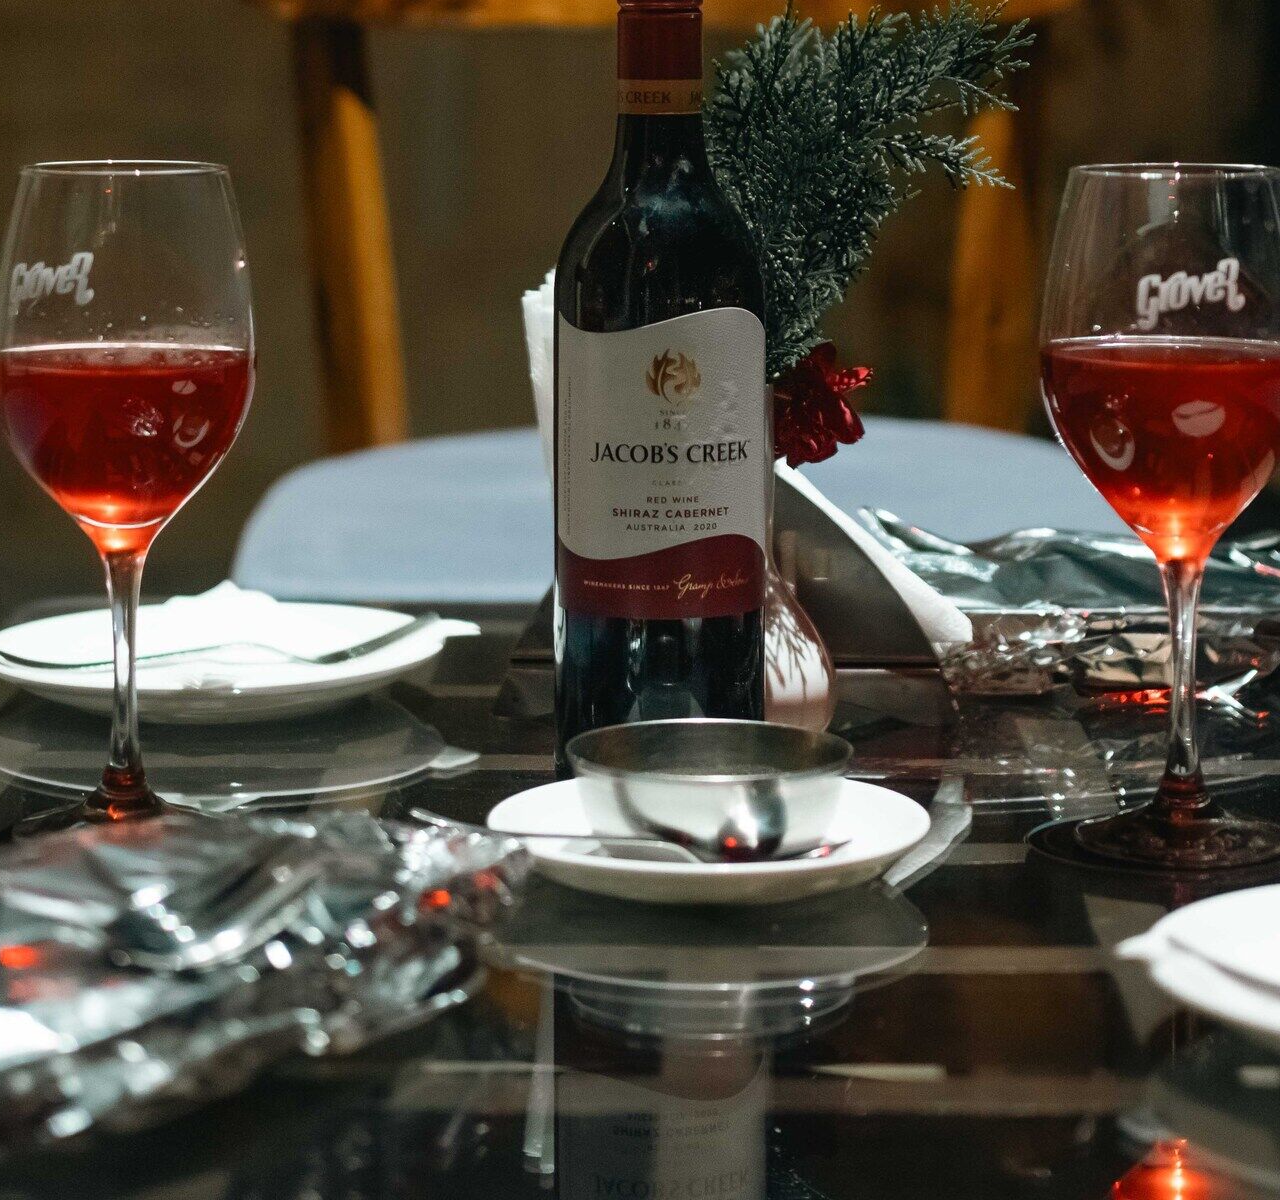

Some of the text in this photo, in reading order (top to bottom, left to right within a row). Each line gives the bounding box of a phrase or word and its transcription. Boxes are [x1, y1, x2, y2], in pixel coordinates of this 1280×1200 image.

[626, 91, 672, 104] CREEK
[590, 440, 749, 464] JACOB'S CREEK
[646, 495, 700, 504] RED WINE
[612, 506, 730, 519] SHIRAZ CABERNET
[626, 522, 718, 532] AUSTRALIA 2020
[583, 579, 626, 590] WINEMAKERS
